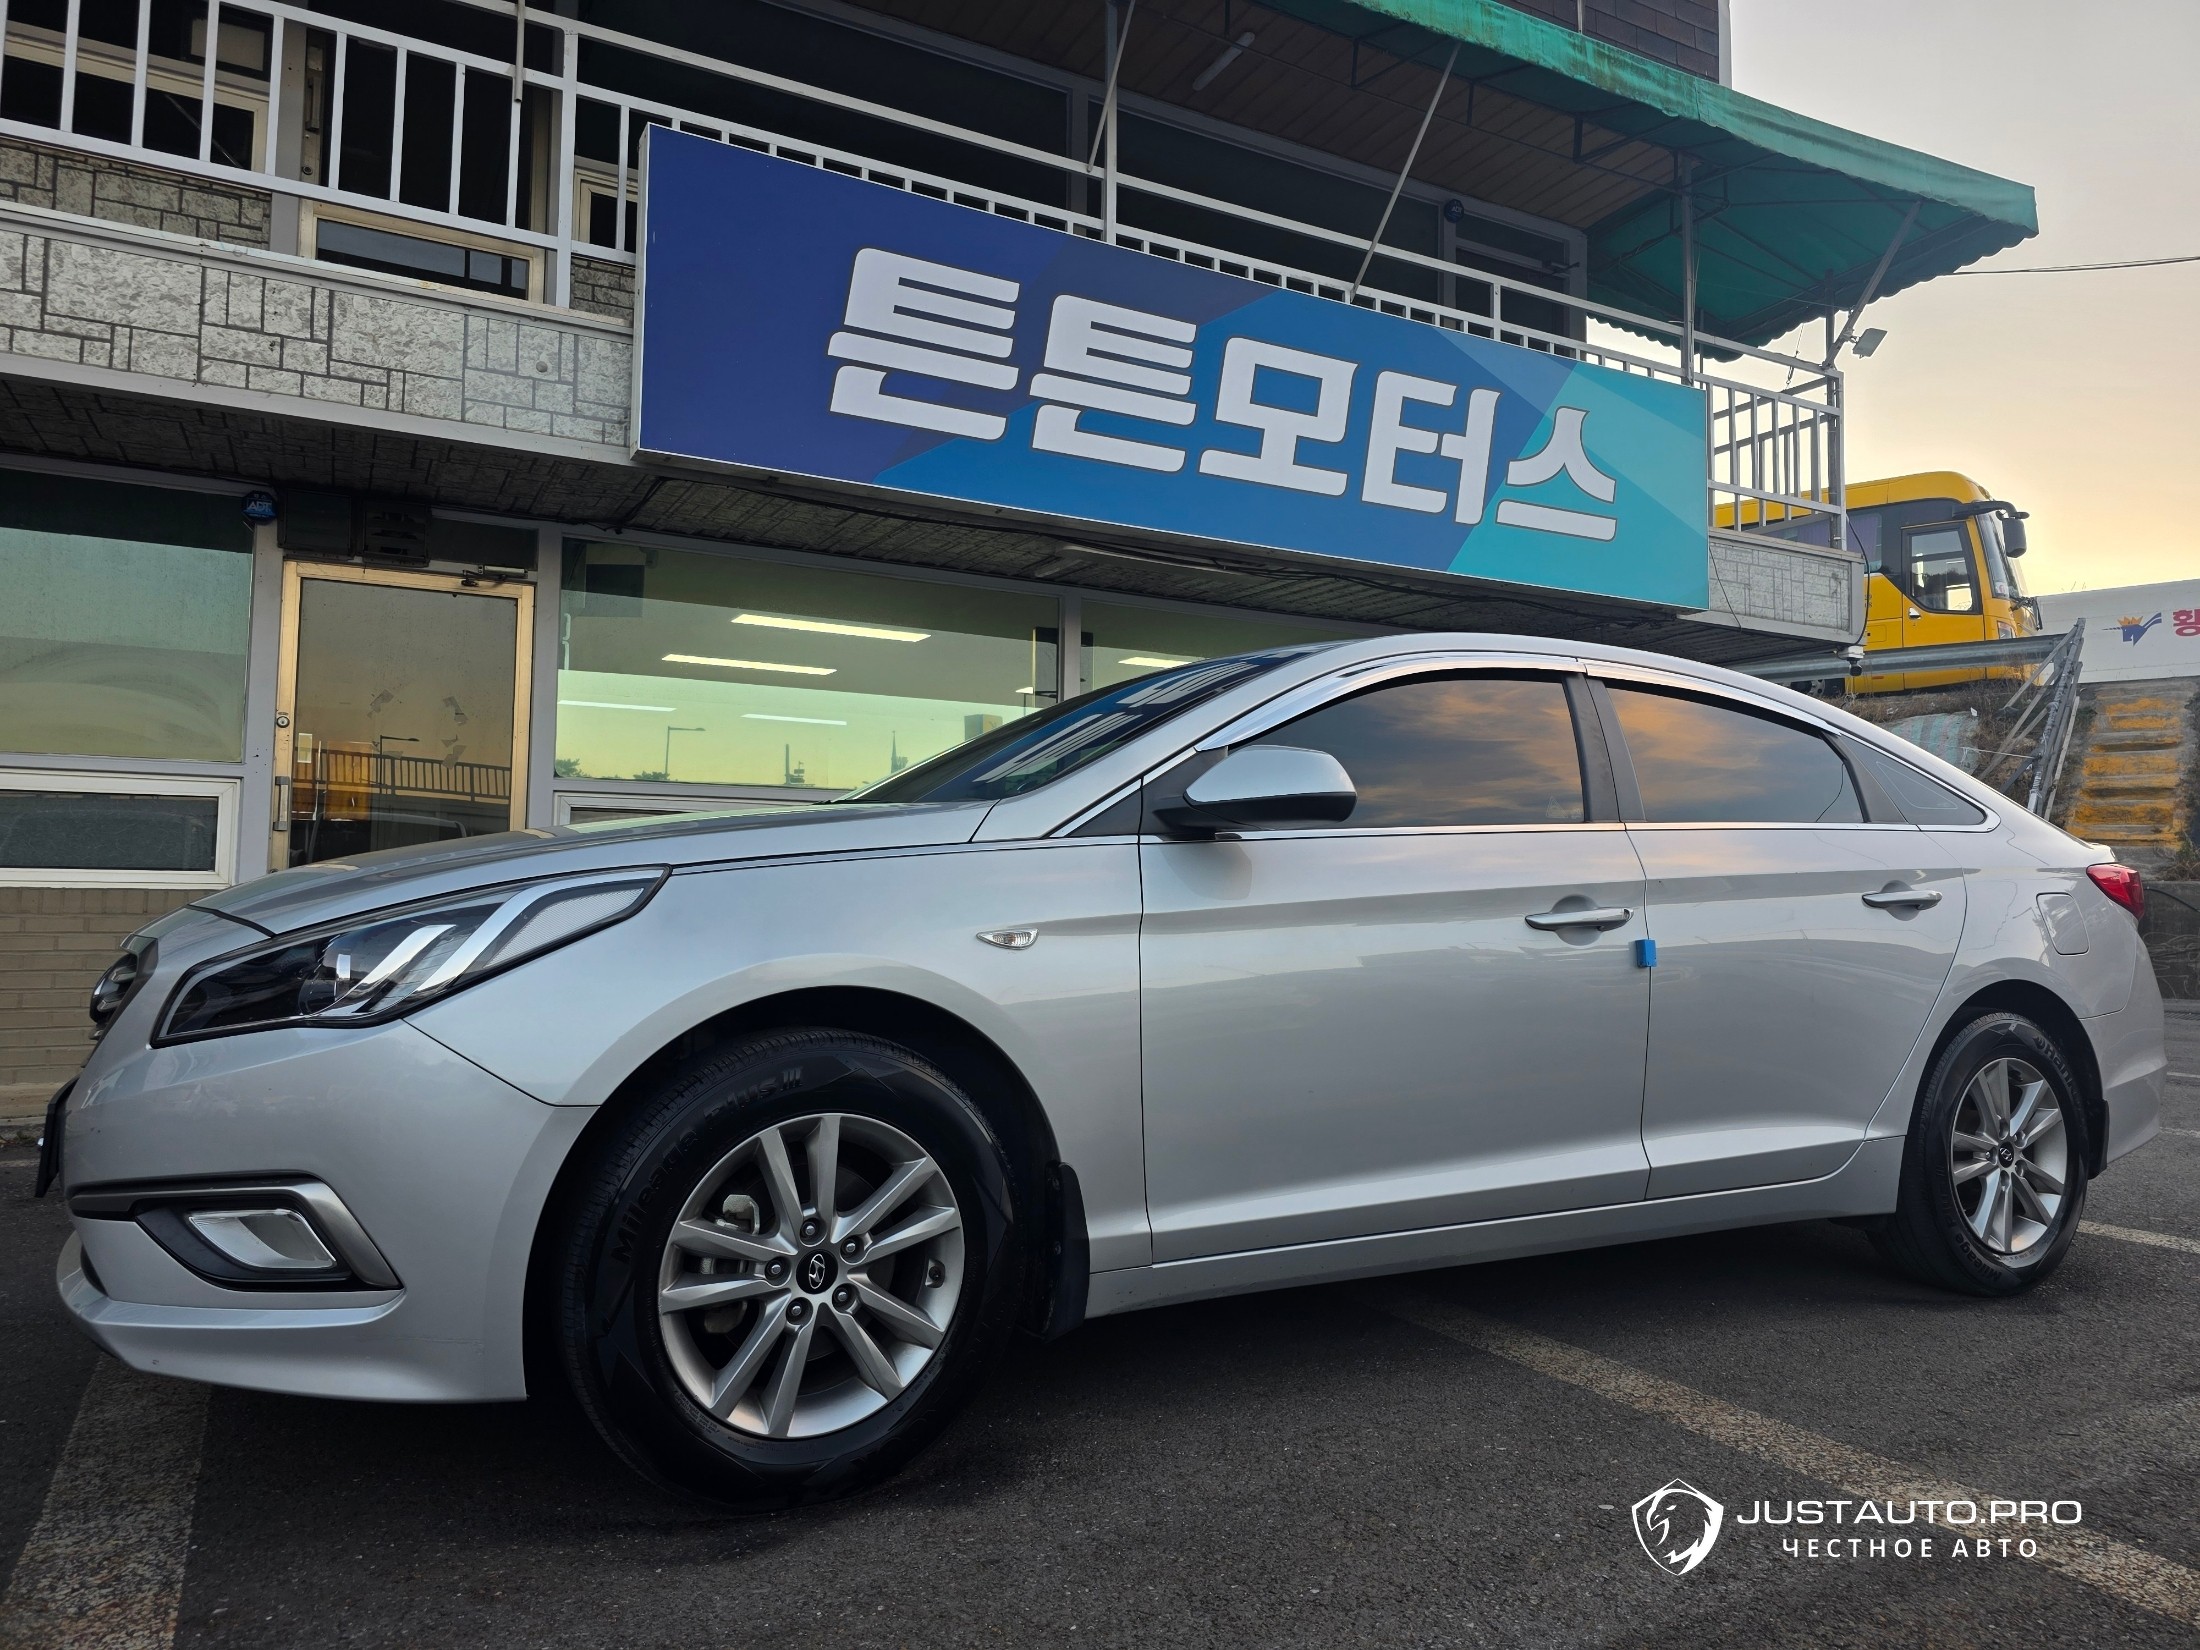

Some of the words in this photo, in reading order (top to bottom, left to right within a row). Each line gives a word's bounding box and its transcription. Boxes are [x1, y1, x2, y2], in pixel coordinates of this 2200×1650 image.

[827, 247, 1618, 542] 튼튼모터스
[247, 500, 273, 512] ADT
[1955, 1232, 2002, 1281] Mileage
